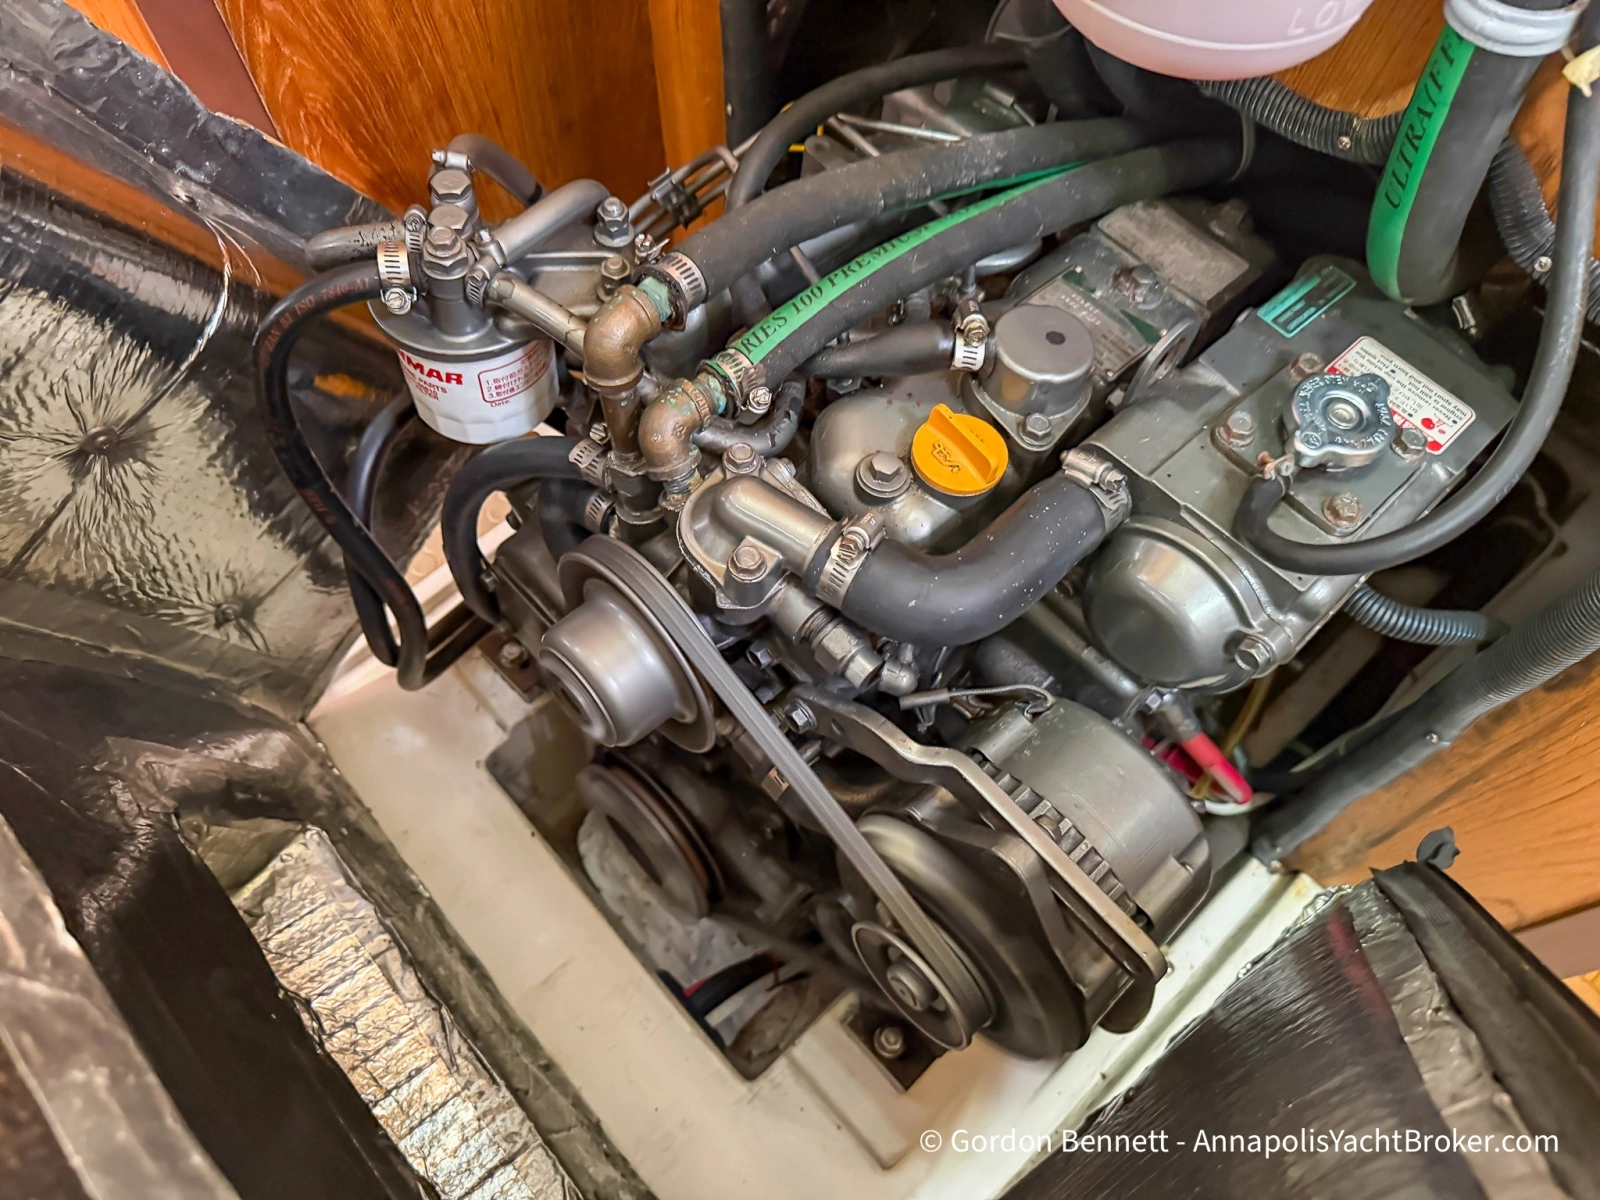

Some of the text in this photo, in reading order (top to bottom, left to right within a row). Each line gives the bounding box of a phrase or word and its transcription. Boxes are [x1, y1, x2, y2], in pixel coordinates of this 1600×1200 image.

[1385, 32, 1465, 209] ULTRA/FF
[294, 295, 316, 316] ISO
[740, 311, 788, 355] RIES
[790, 284, 824, 315] 100
[1354, 349, 1366, 359] the
[1358, 346, 1389, 369] Hot water
[1365, 357, 1384, 372] while
[1392, 362, 1409, 375] burn
[1382, 369, 1397, 380] cap
[1408, 374, 1422, 385] and
[1394, 378, 1407, 389] the
[1421, 383, 1434, 393] out
[1406, 387, 1432, 406] remove
[1418, 389, 1433, 400] still
[1433, 391, 1452, 406] spurt
[1431, 405, 1451, 421] Never
[1439, 403, 1463, 421] engine
[1451, 404, 1468, 417] may
